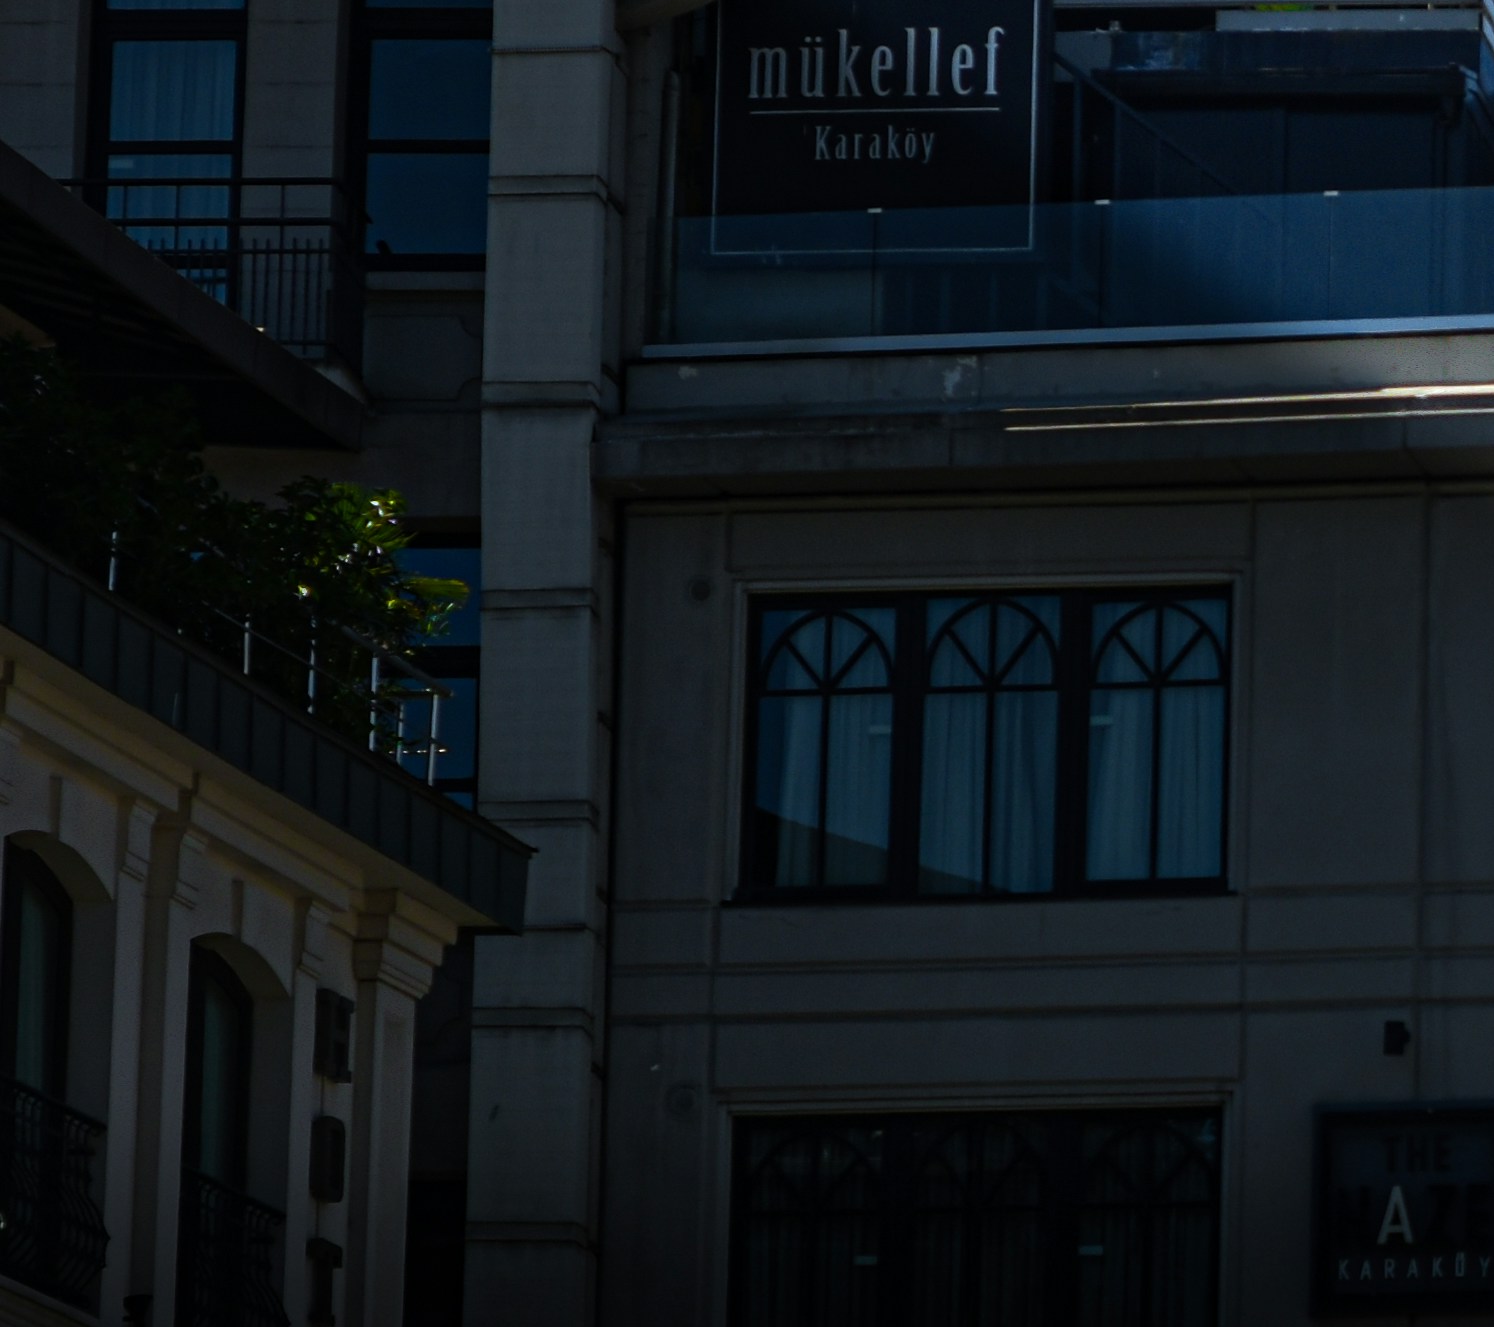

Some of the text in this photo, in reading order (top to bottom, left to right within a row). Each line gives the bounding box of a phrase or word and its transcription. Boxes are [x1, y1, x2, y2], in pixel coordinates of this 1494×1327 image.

[748, 25, 1006, 99] mükellef
[814, 125, 936, 163] Karaköy
[1383, 1134, 1451, 1173] THE
[1338, 1251, 1491, 1280] KARAKÖY
